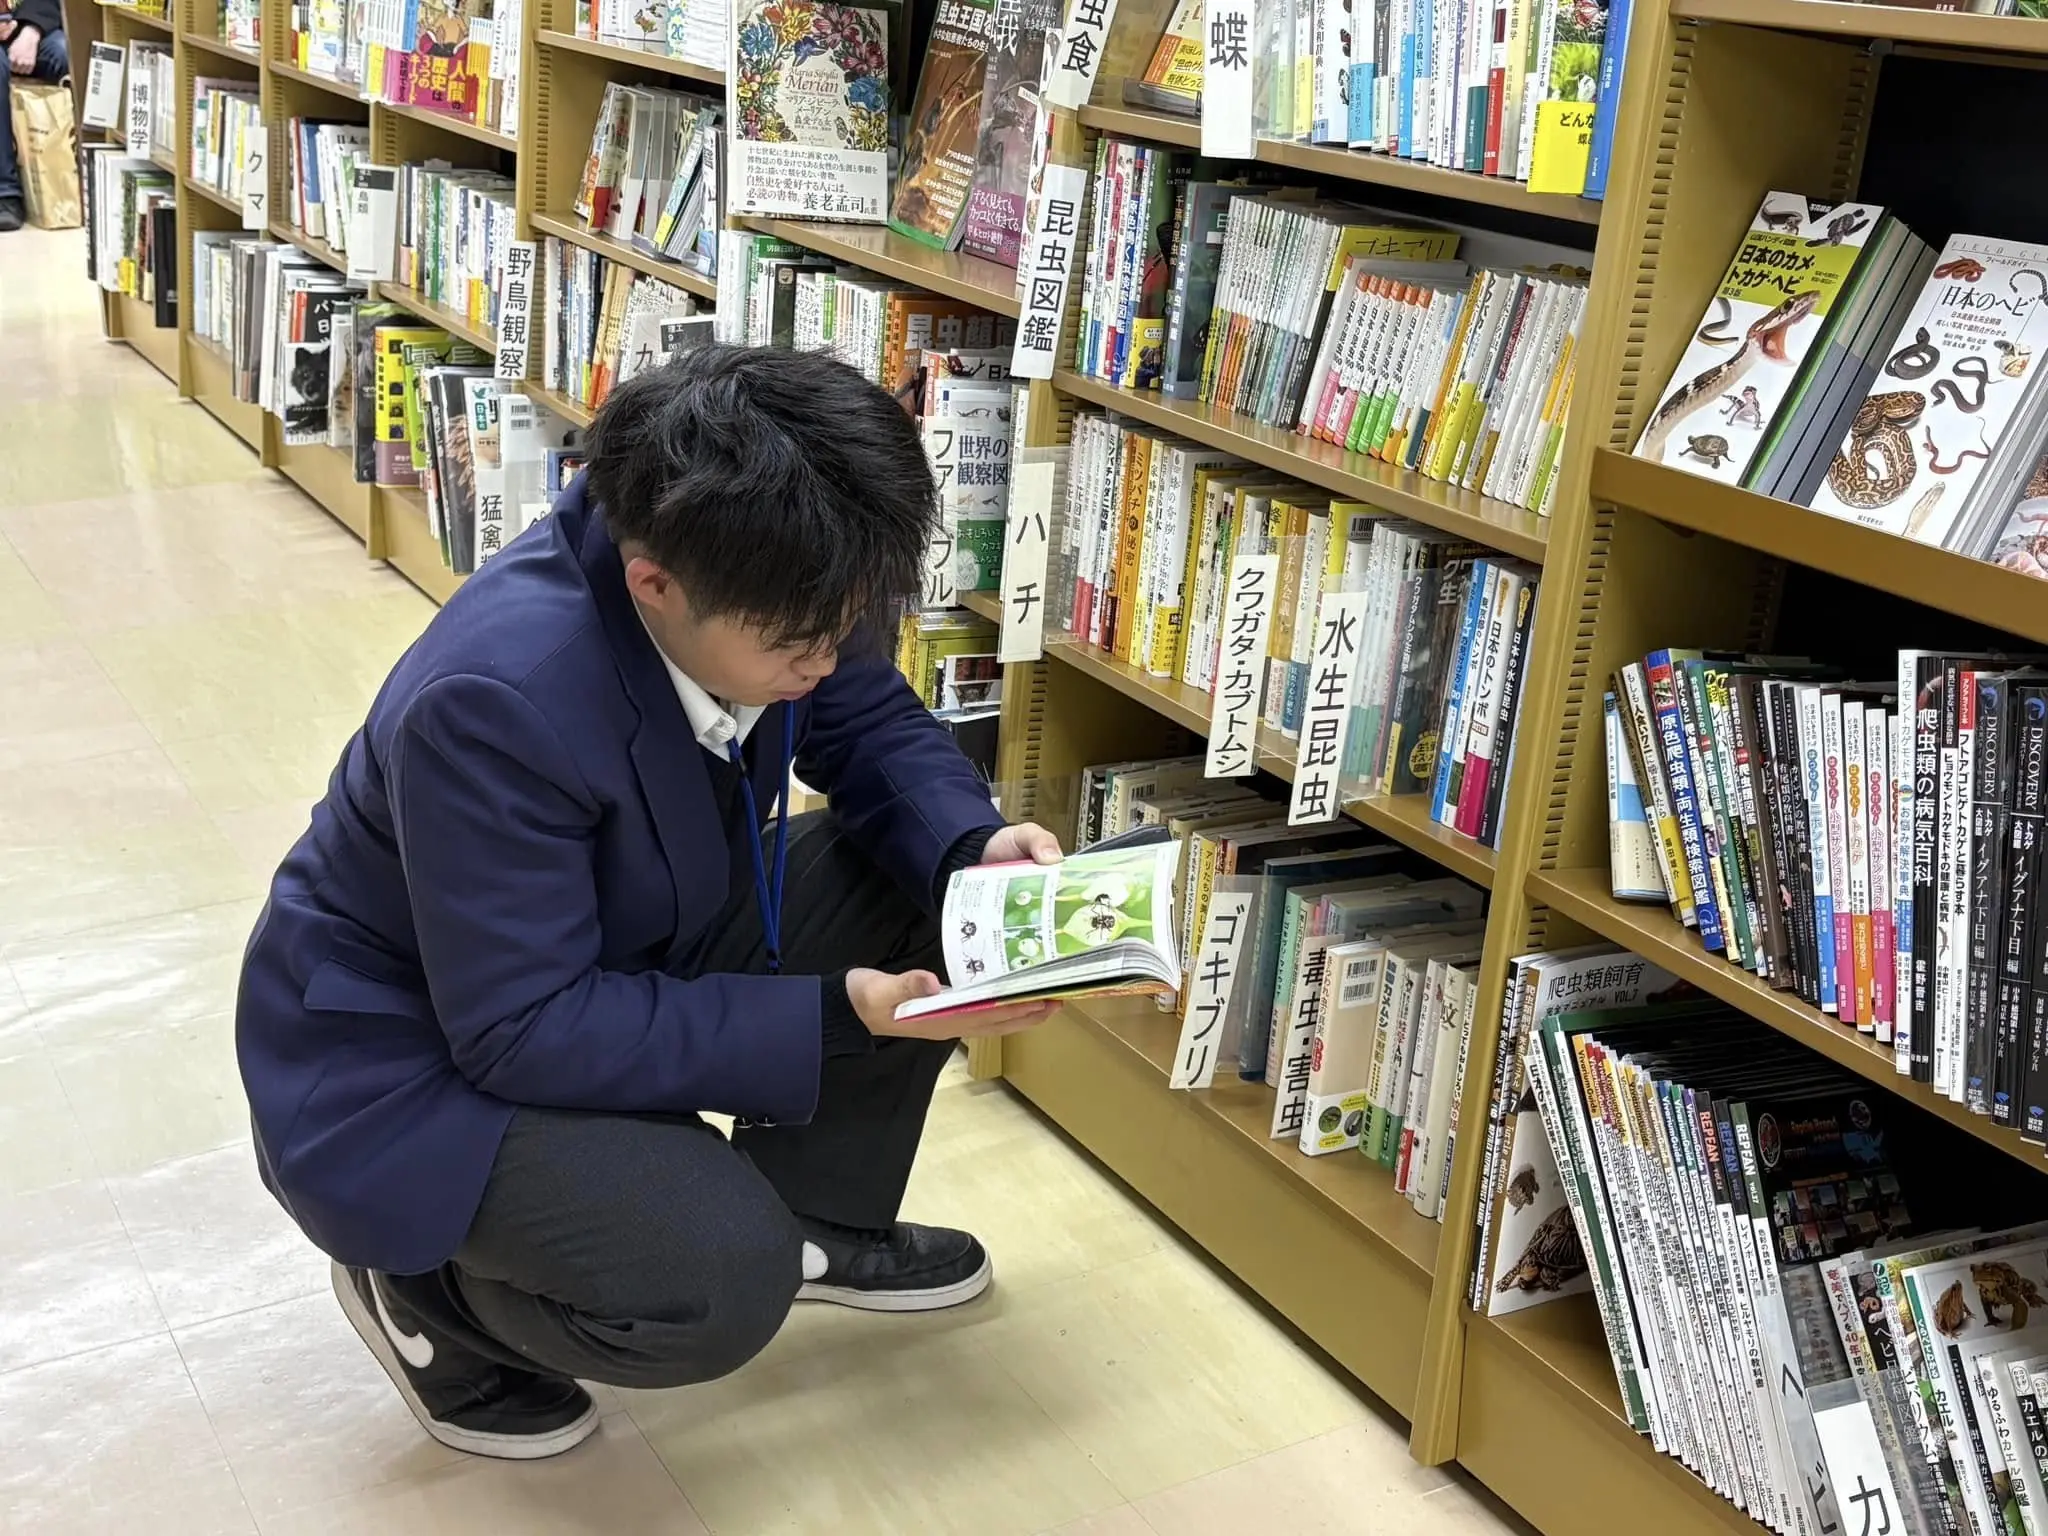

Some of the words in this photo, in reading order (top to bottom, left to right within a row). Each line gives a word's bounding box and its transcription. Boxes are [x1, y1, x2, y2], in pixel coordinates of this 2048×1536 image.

[1209, 11, 1249, 72] 蝶
[430, 56, 449, 102] 歴史は
[784, 74, 840, 94] Merian
[128, 143, 150, 210] 博物学
[803, 192, 865, 214] 養老孟司
[247, 210, 266, 272] クマ
[1021, 198, 1074, 353] 昆虫図鑑
[1738, 244, 1816, 272] 日本のカメ・
[499, 246, 532, 378] 野鳥観察
[1726, 265, 1805, 295] トカゲ・ヘビ
[1940, 284, 2037, 318] 日本のヘビ
[957, 432, 1010, 461] 世界の
[926, 428, 957, 605] ファーブル
[1014, 510, 1049, 626] ハチ
[1214, 566, 1268, 775] クワガタ・カブトムシ
[1476, 621, 1504, 720] 日本のトンボ
[1499, 631, 1523, 722] 日本の水生昆虫
[1294, 606, 1358, 821] 水生昆虫
[1901, 658, 1912, 781] ヒョウモントカゲモドキ
[1983, 715, 1999, 799] DISCOVERY
[2024, 726, 2044, 810] DISCOVERY
[1659, 714, 1711, 906] 原色爬虫類・両生類検索図鑑
[1913, 708, 1939, 888] 爬虫類の病気百科
[1953, 732, 1970, 916] フトアゴヒゲトカゲと暮らす本
[1984, 808, 1994, 837] トカゲ
[1809, 804, 1826, 887] ニホンヤモリ
[1850, 819, 1863, 866] トカゲ
[1898, 807, 1911, 898] お悩み解決事典
[2023, 820, 2035, 850] トカゲ
[1184, 903, 1246, 1089] ゴキブリ
[1547, 961, 1647, 1001] 爬虫類飼育
[1577, 1049, 1598, 1114] VivariumGuide
[1588, 1055, 1607, 1121] VivariumGuide
[1647, 1096, 1669, 1165] VivariumGuide
[1661, 1095, 1682, 1164] VivariumGuide
[1673, 1098, 1693, 1167] VivariumGuide
[1685, 1103, 1704, 1172] VivariumGuide
[1901, 1366, 1940, 1464] ビバリウム
[1934, 1388, 1955, 1428] カエル
[1780, 1362, 1838, 1536] ヘビ
[1986, 1385, 2032, 1508] ゆるふわカエル図鑑
